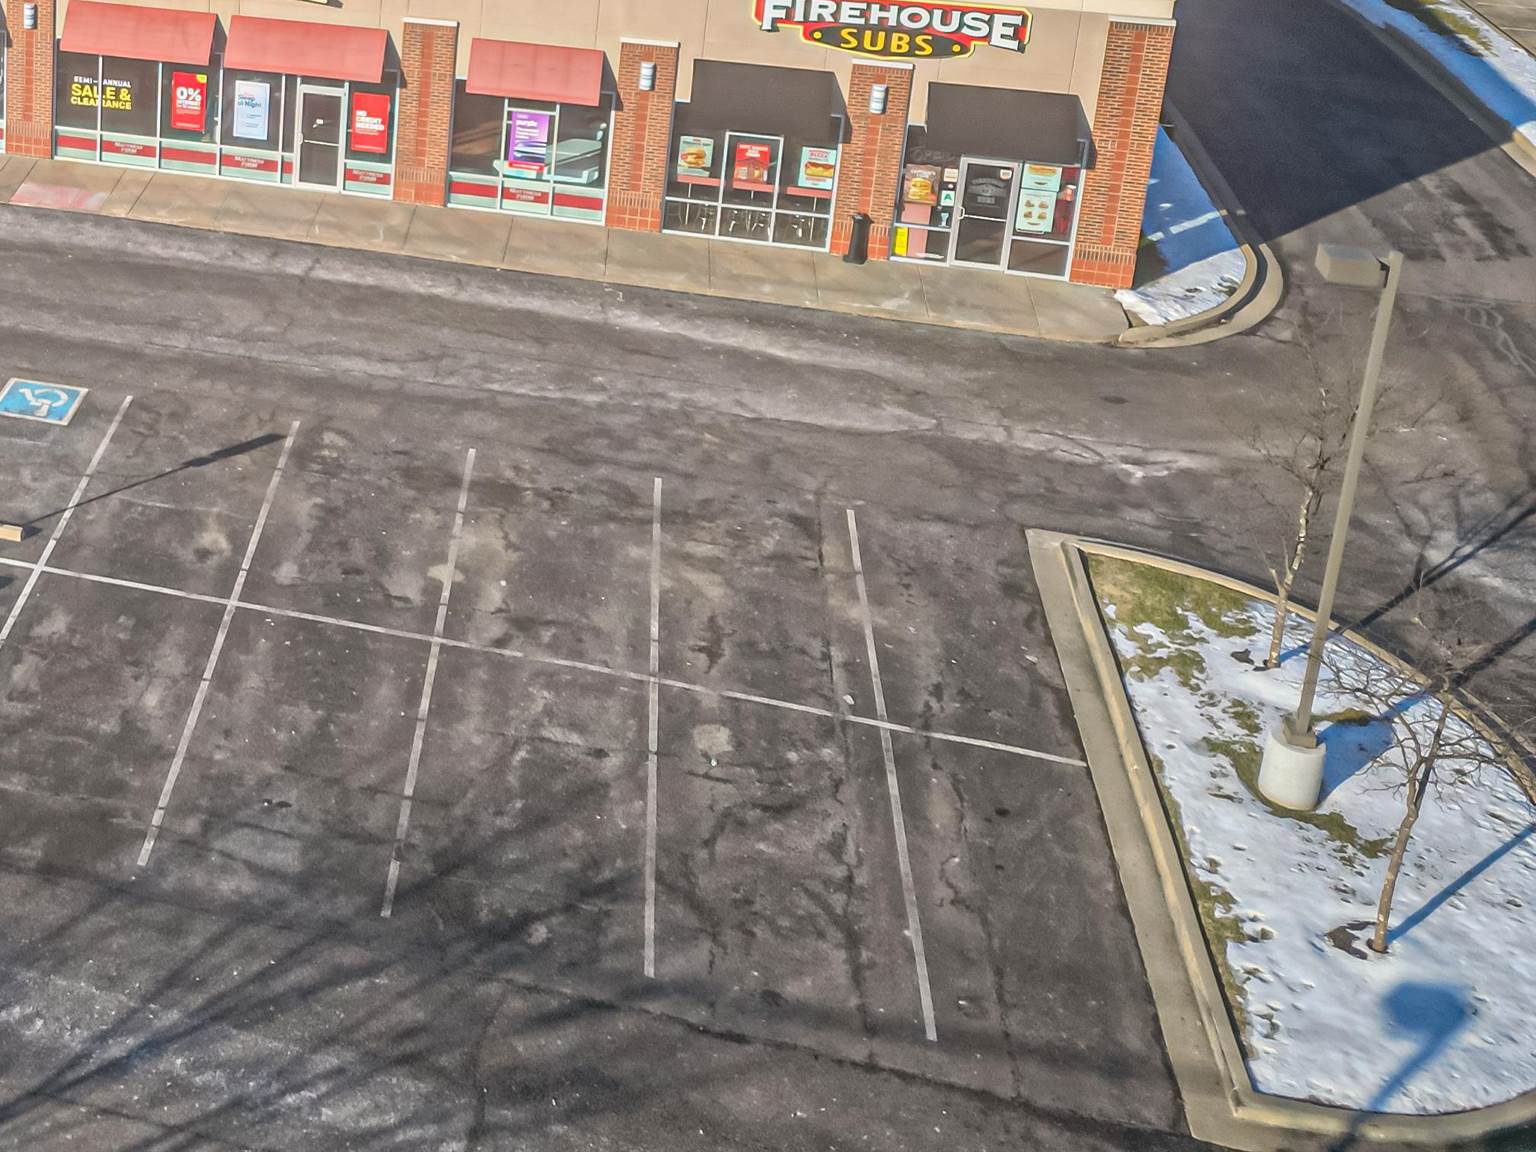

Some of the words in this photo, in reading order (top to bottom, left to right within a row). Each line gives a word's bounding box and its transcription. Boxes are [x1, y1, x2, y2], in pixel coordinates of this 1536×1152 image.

[840, 27, 933, 56] SUBS
[71, 83, 116, 100] SALE
[120, 88, 132, 102] &
[176, 86, 202, 102] 0%
